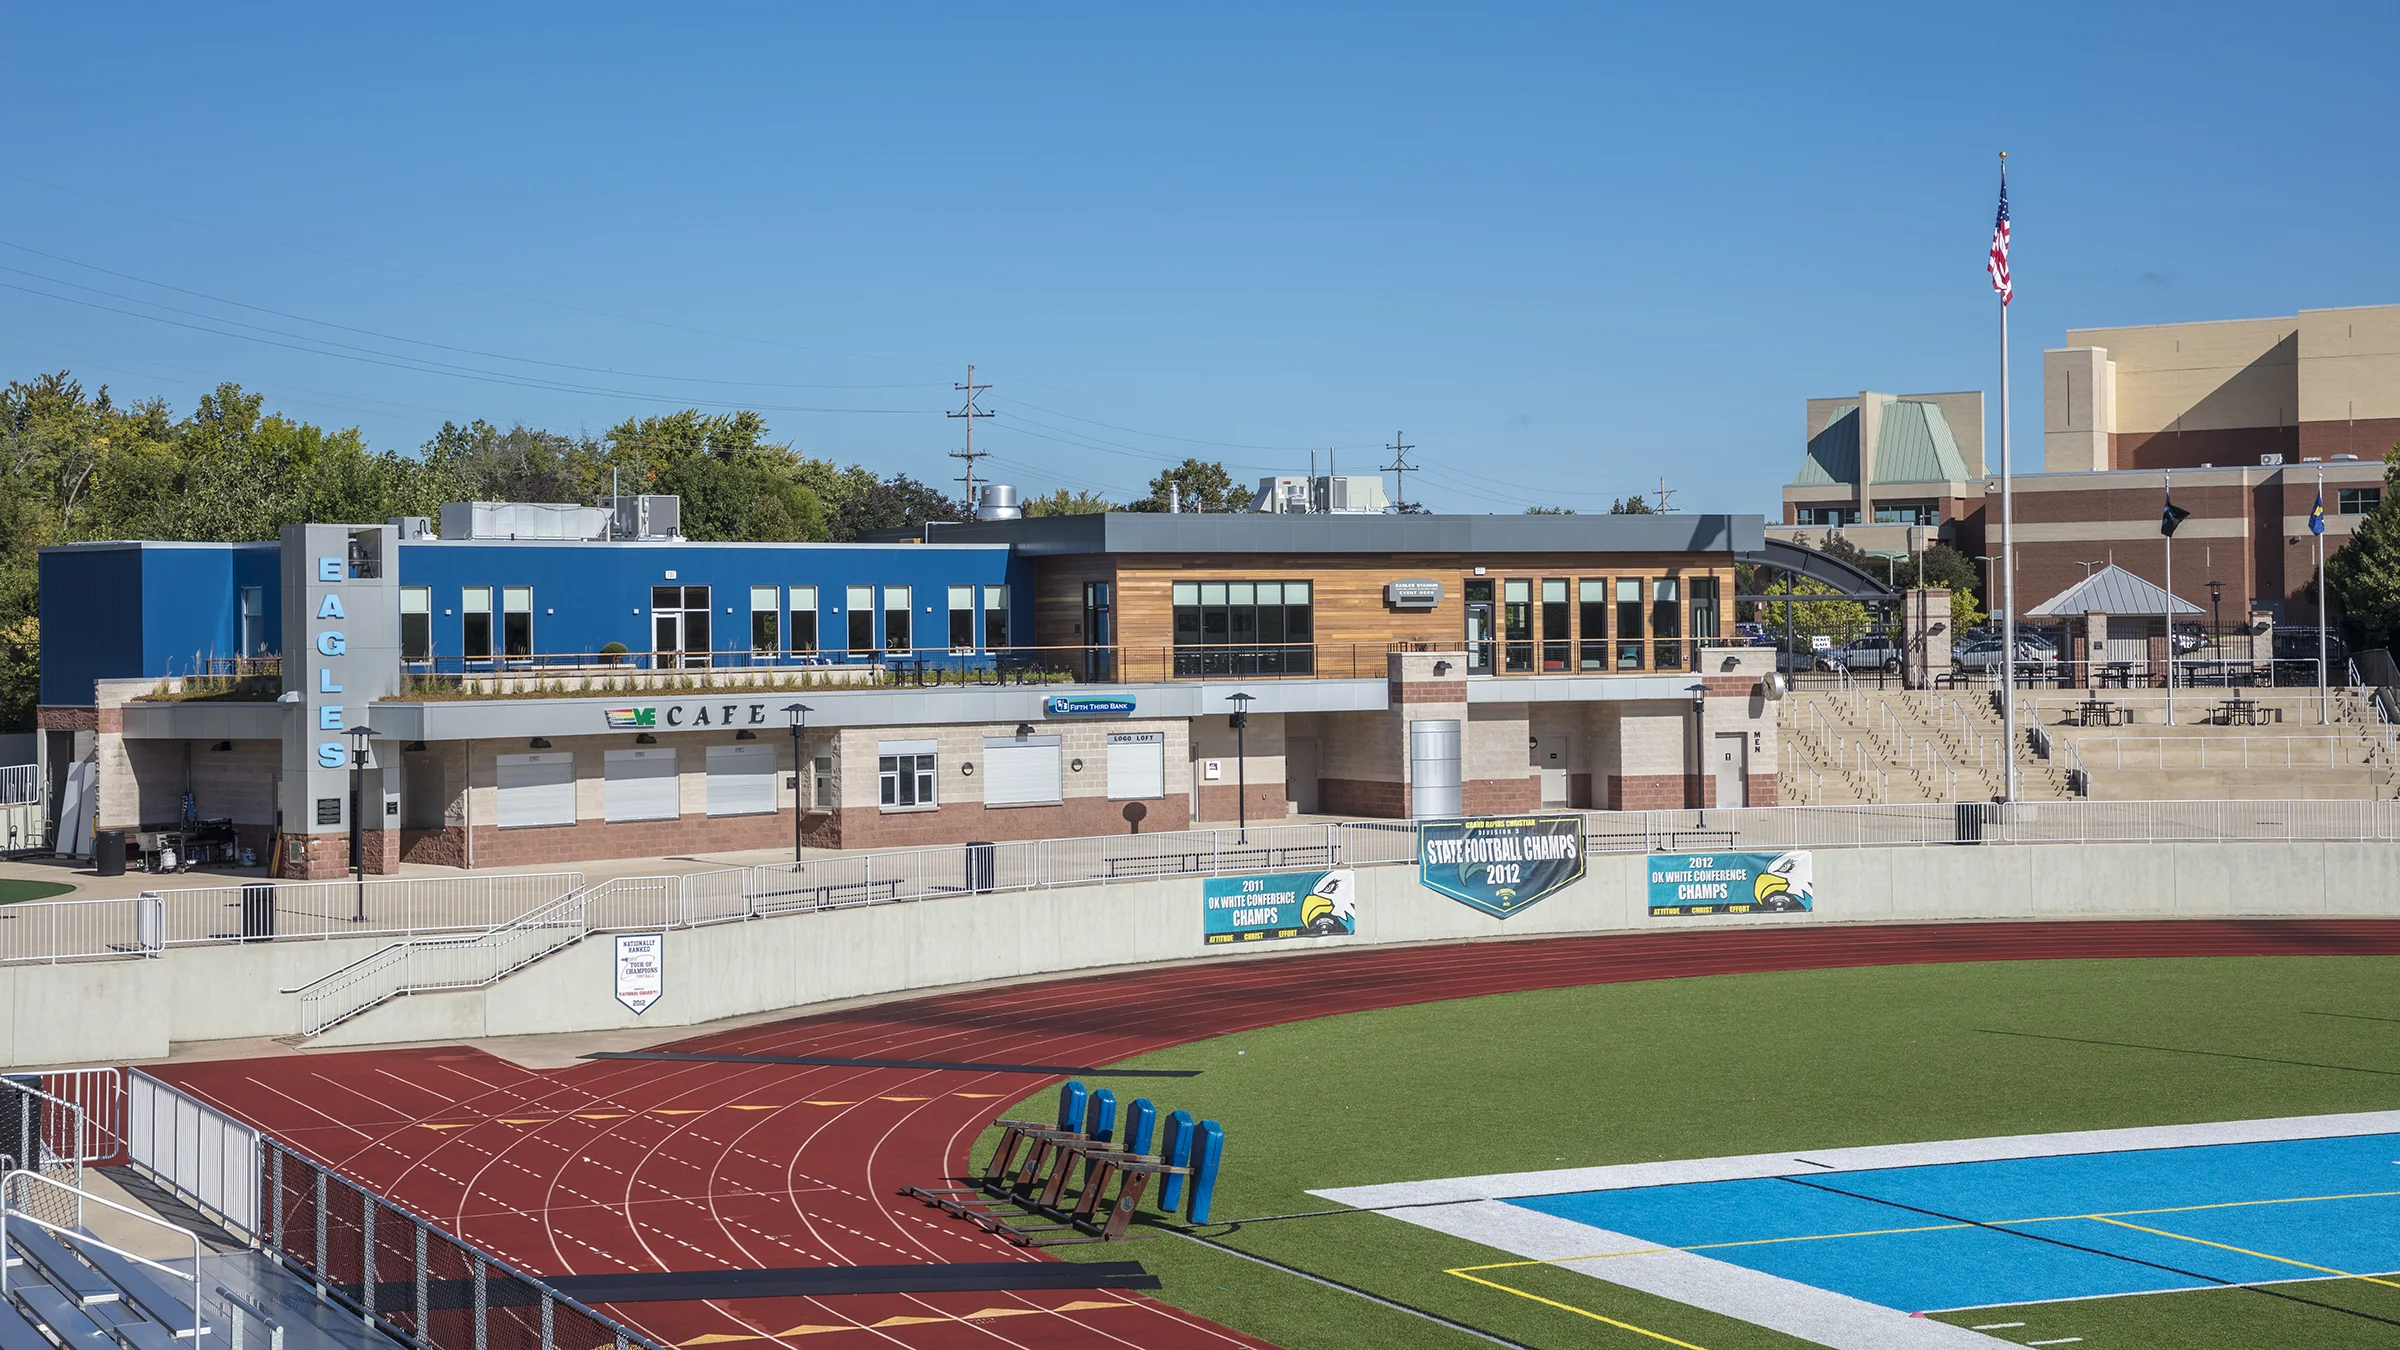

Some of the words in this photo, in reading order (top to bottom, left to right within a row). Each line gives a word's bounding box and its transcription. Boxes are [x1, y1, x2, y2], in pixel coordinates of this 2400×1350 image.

[317, 557, 347, 769] EAGLES
[666, 704, 766, 727] CAFE
[1465, 820, 1484, 829] GRAND
[1485, 820, 1505, 828] RAPIDS
[1505, 818, 1536, 827] CHRISTIAN
[1478, 828, 1511, 836] DIVISION
[1427, 839, 1463, 865] STATE
[1463, 836, 1523, 863] FOOTBALL
[1523, 834, 1577, 861] CHAMPS
[1689, 857, 1714, 869] 2012
[1487, 863, 1521, 885] 2012
[1652, 871, 1665, 883] OK
[1665, 870, 1692, 883] WHITE
[1693, 869, 1747, 882] CONFERENCE
[1242, 879, 1264, 893] 2011
[1678, 883, 1728, 901] CHAMPS
[1208, 896, 1220, 909] OK
[1220, 895, 1246, 909] WHITE
[1246, 891, 1295, 907] CONFERENCE
[1232, 907, 1278, 927] CHAMPS
[1653, 907, 1681, 915] ATTITUDE
[1691, 906, 1713, 914] CHRIST
[1729, 905, 1750, 913] EFFORT
[1209, 934, 1234, 944] ATTITUDE
[1243, 931, 1264, 941] CHRIST
[1278, 929, 1298, 938] EFFORT
[625, 967, 658, 975] CHAMPIONS
